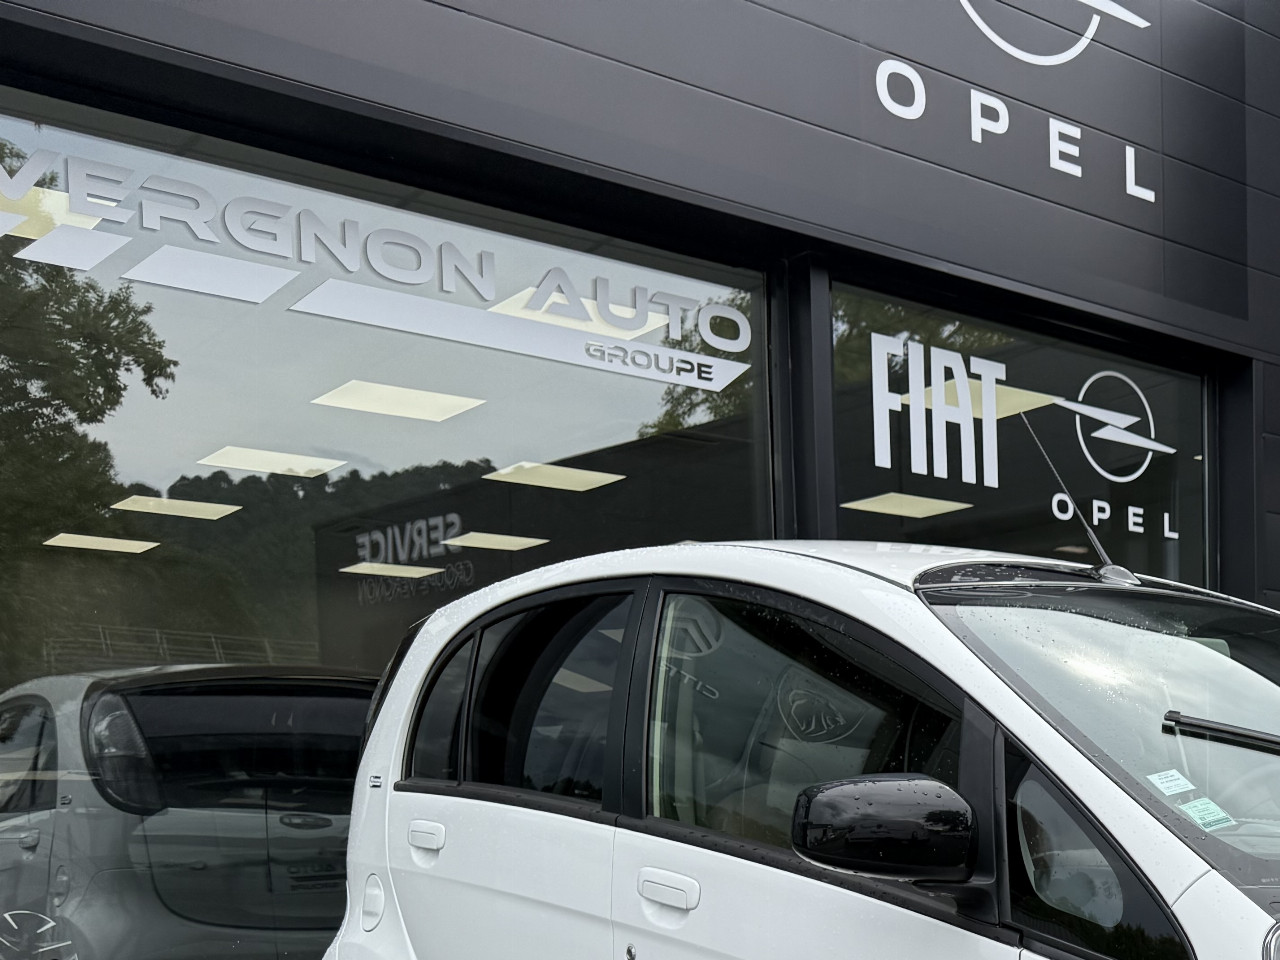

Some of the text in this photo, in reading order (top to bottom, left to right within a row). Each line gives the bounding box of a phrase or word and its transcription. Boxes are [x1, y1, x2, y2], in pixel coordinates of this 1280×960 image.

[875, 59, 1156, 203] OPEL
[0, 149, 752, 354] VERGNON AUTO
[584, 339, 715, 383] GROUPE
[870, 331, 1007, 489] FIAT
[1051, 491, 1180, 540] OPEL
